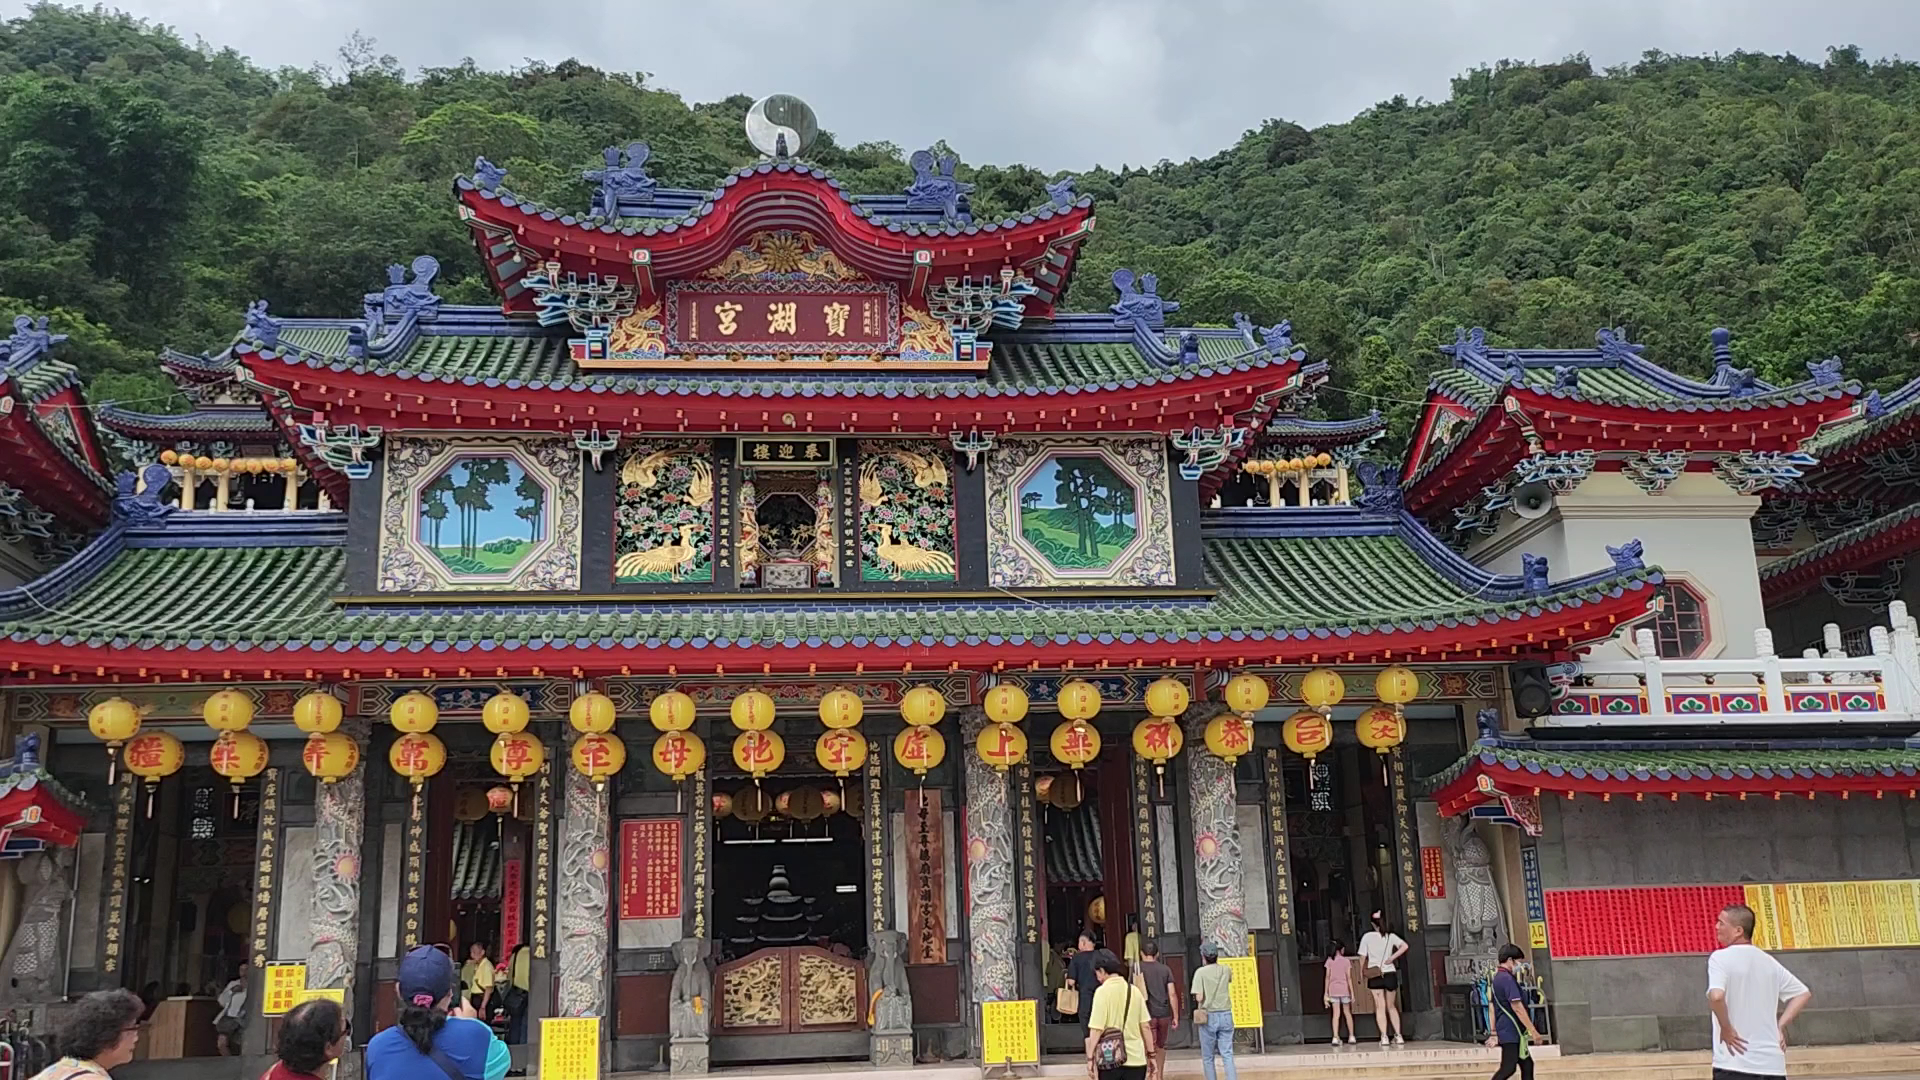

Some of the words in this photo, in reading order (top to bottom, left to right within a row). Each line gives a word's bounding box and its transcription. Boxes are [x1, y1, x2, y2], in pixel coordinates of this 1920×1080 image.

[714, 300, 851, 337] 寶湖宮
[900, 728, 932, 760] 虛
[986, 728, 1019, 757] 上
[1061, 724, 1093, 756] 無
[1144, 722, 1178, 753] 祝
[1217, 719, 1249, 749] 恭
[1295, 714, 1326, 746] 乙巳
[130, 736, 165, 768] 疆
[304, 737, 332, 770] 壽
[395, 737, 430, 770] 萬
[498, 739, 533, 771] 尊
[580, 737, 611, 767] 至
[659, 737, 692, 768] 母
[741, 732, 775, 764] 地
[823, 732, 856, 764] 空
[1531, 925, 1545, 937] 入口
